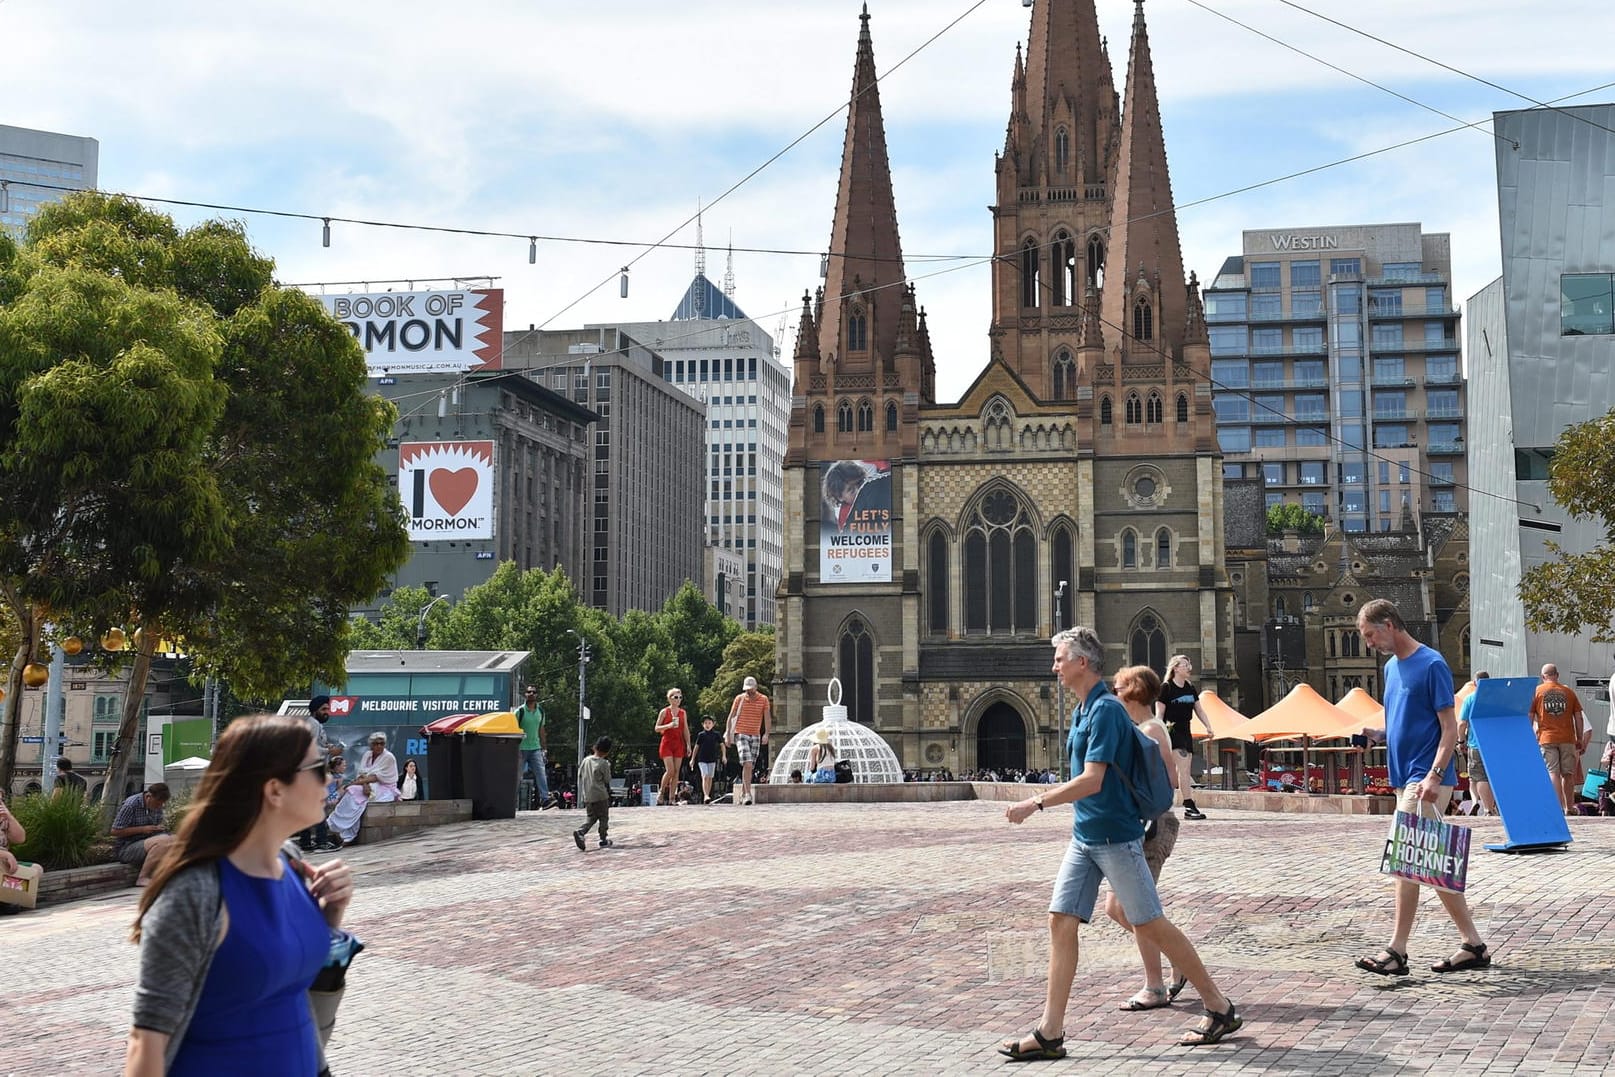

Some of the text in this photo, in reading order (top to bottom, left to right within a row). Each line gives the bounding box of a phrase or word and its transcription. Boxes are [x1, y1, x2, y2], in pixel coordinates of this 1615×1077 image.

[1270, 235, 1338, 249] WESTIN
[334, 294, 464, 319] BOOK OF
[854, 509, 889, 520] LET'S
[849, 522, 889, 533] FULLY
[830, 535, 889, 546] WELCOME
[827, 548, 889, 559] REFUGEES
[361, 700, 500, 711] MELBOURNE VISITOR CENTRE
[1398, 824, 1439, 851] DAVID
[1395, 842, 1464, 876] HOCKNEY
[1394, 862, 1431, 878] CURRENT
